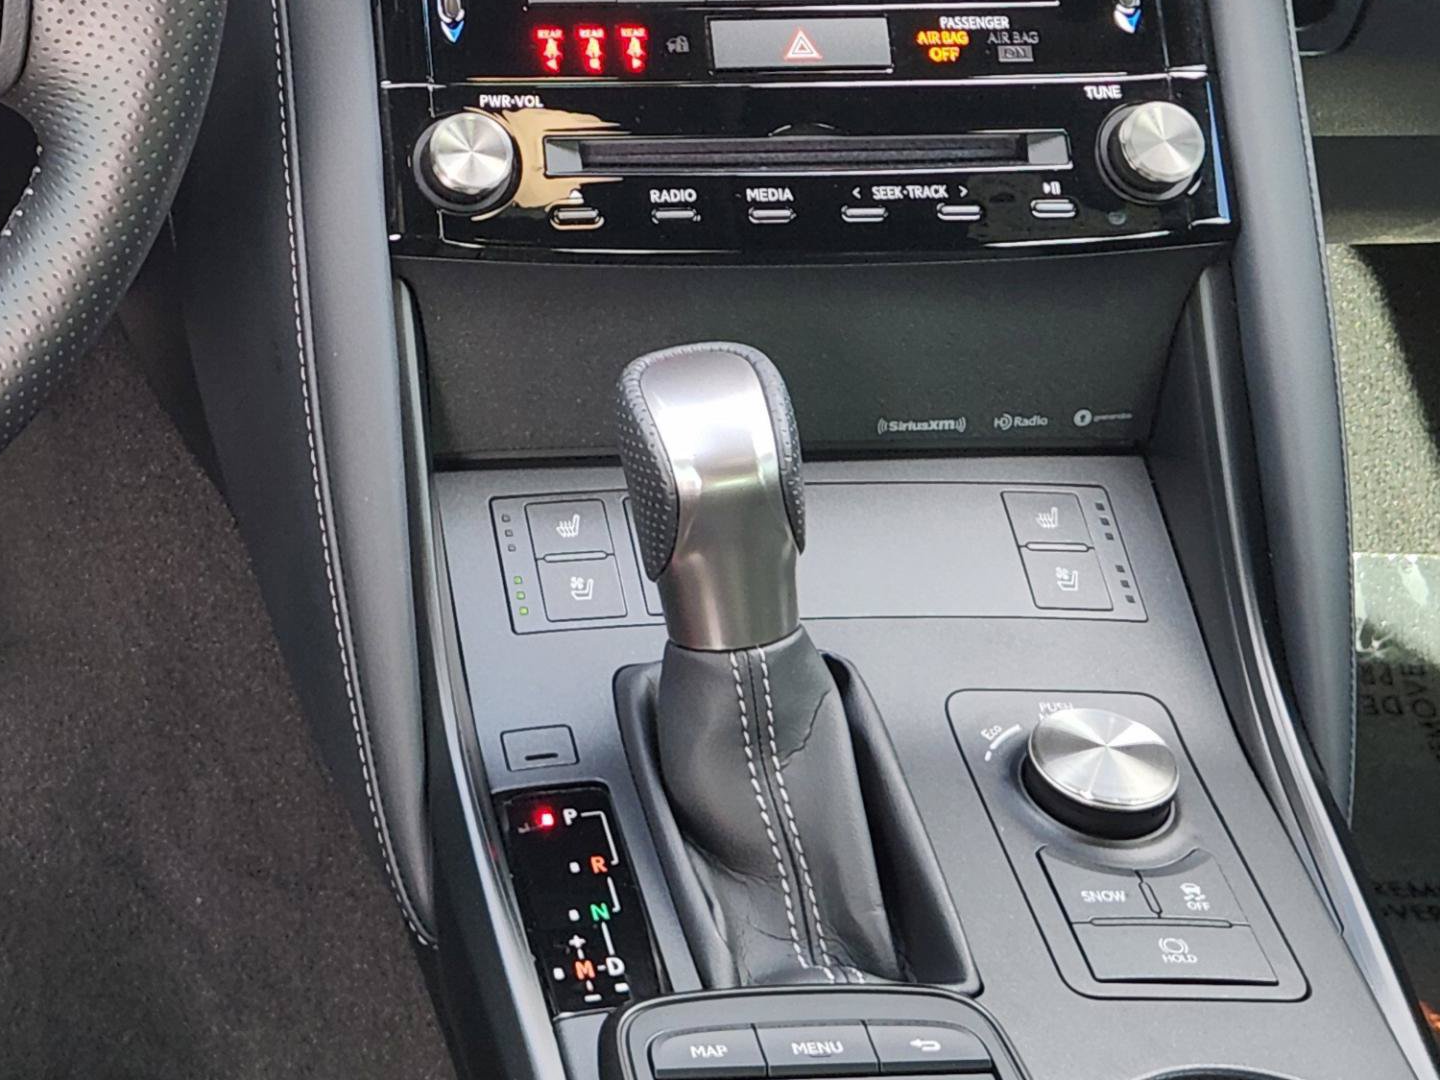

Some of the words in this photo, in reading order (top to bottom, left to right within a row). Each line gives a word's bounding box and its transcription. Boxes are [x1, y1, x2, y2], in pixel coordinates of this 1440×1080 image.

[939, 16, 1010, 30] PASSENGER
[916, 31, 940, 45] AIR
[941, 31, 969, 45] BAG
[987, 32, 1011, 44] AIR
[1013, 32, 1040, 44] BAG
[928, 47, 961, 62] OFF
[1083, 85, 1123, 100] TUNE
[650, 188, 698, 202] RADIO
[746, 188, 794, 202] MEDIA
[1014, 415, 1048, 427] Radio
[980, 724, 1003, 741] Eco
[562, 808, 578, 825] P
[590, 856, 608, 874] R
[1081, 890, 1127, 903] SNOW
[590, 904, 610, 921] N
[1187, 901, 1211, 912] OFF
[1162, 953, 1198, 964] HOLD
[575, 960, 596, 980] M
[605, 957, 625, 976] D
[690, 1044, 728, 1059] MAP
[791, 1039, 844, 1055] MENU
